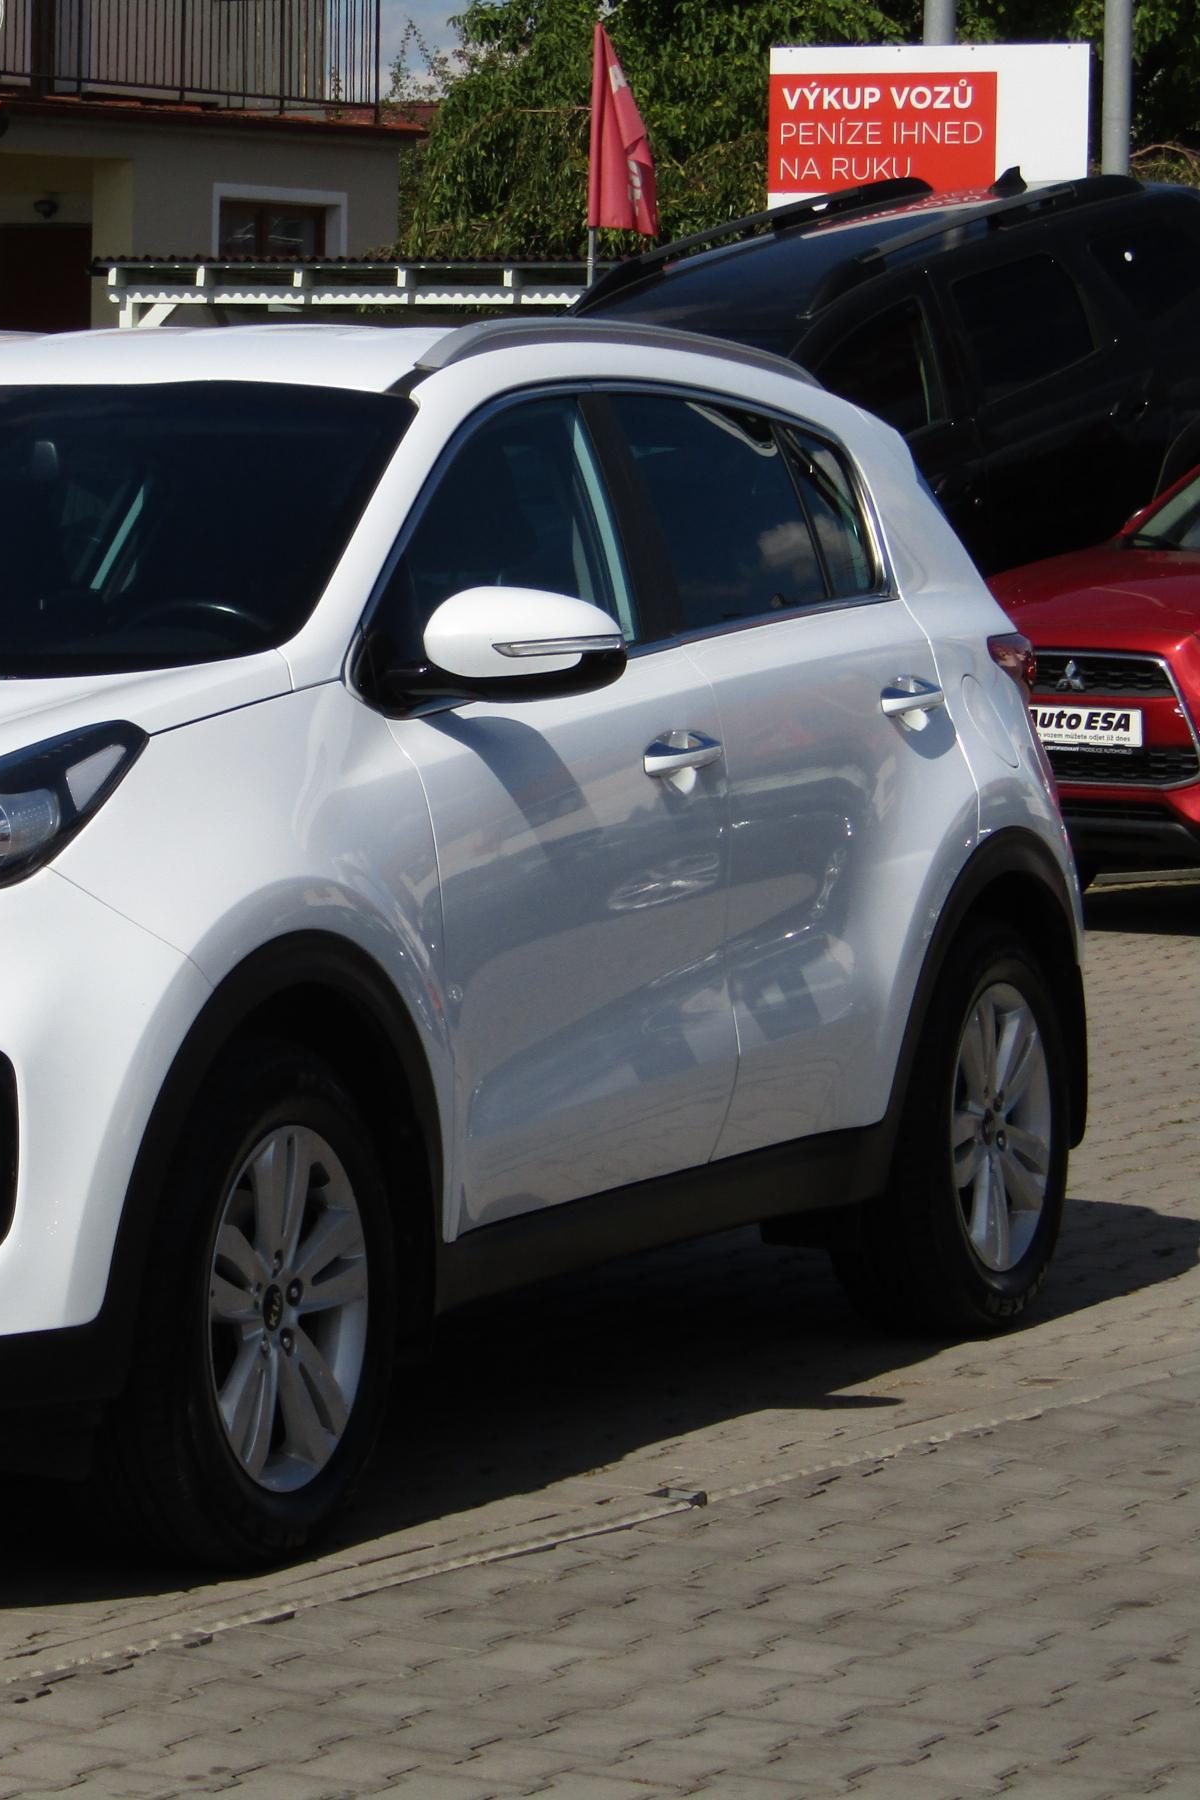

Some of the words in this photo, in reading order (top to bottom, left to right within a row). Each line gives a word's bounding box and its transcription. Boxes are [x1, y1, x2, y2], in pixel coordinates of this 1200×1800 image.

[782, 81, 881, 109] VÝKUP
[890, 79, 973, 108] VOZŮ
[780, 118, 882, 145] PENÍZE
[893, 121, 982, 144] IHNED
[780, 158, 820, 180] NA
[832, 157, 911, 180] RUKU
[1084, 712, 1131, 732] ESA
[1065, 732, 1087, 740] můžete
[1089, 734, 1105, 742] odjet
